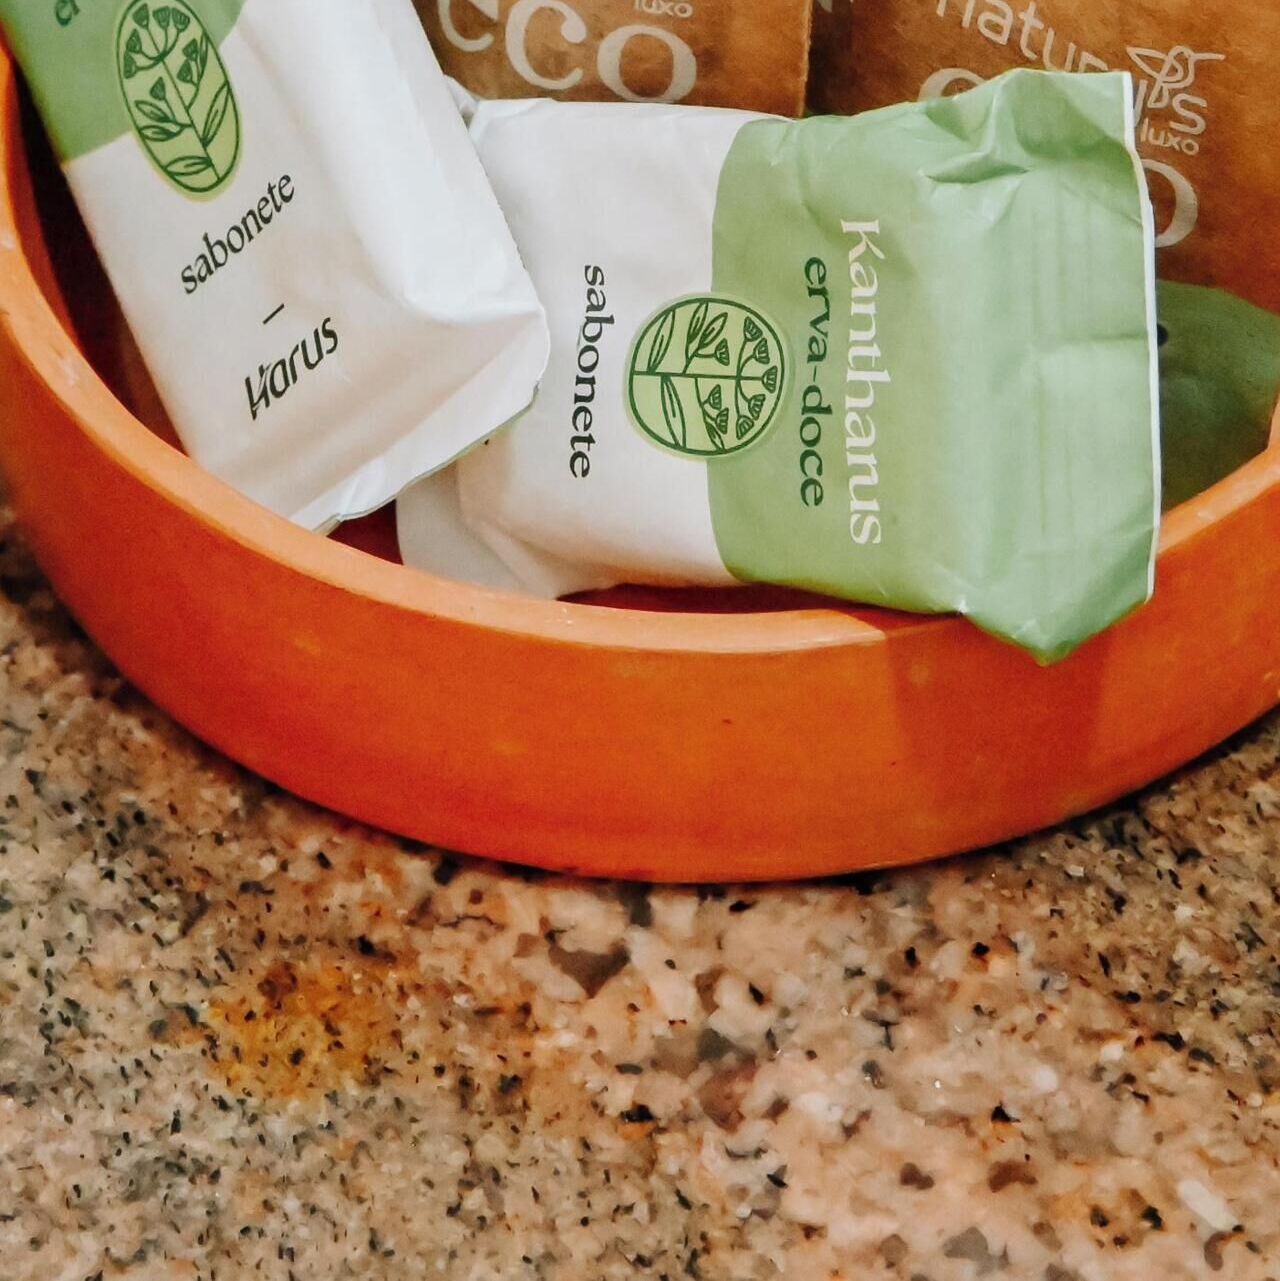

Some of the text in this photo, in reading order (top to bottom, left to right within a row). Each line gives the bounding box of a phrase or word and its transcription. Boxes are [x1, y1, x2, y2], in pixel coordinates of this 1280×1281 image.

[1140, 117, 1200, 156] luxo
[180, 173, 296, 296] sabonete
[244, 317, 339, 421] Harus
[569, 264, 616, 479] sabonete
[799, 256, 834, 507] erva-doce
[839, 219, 892, 545] Kantharus
